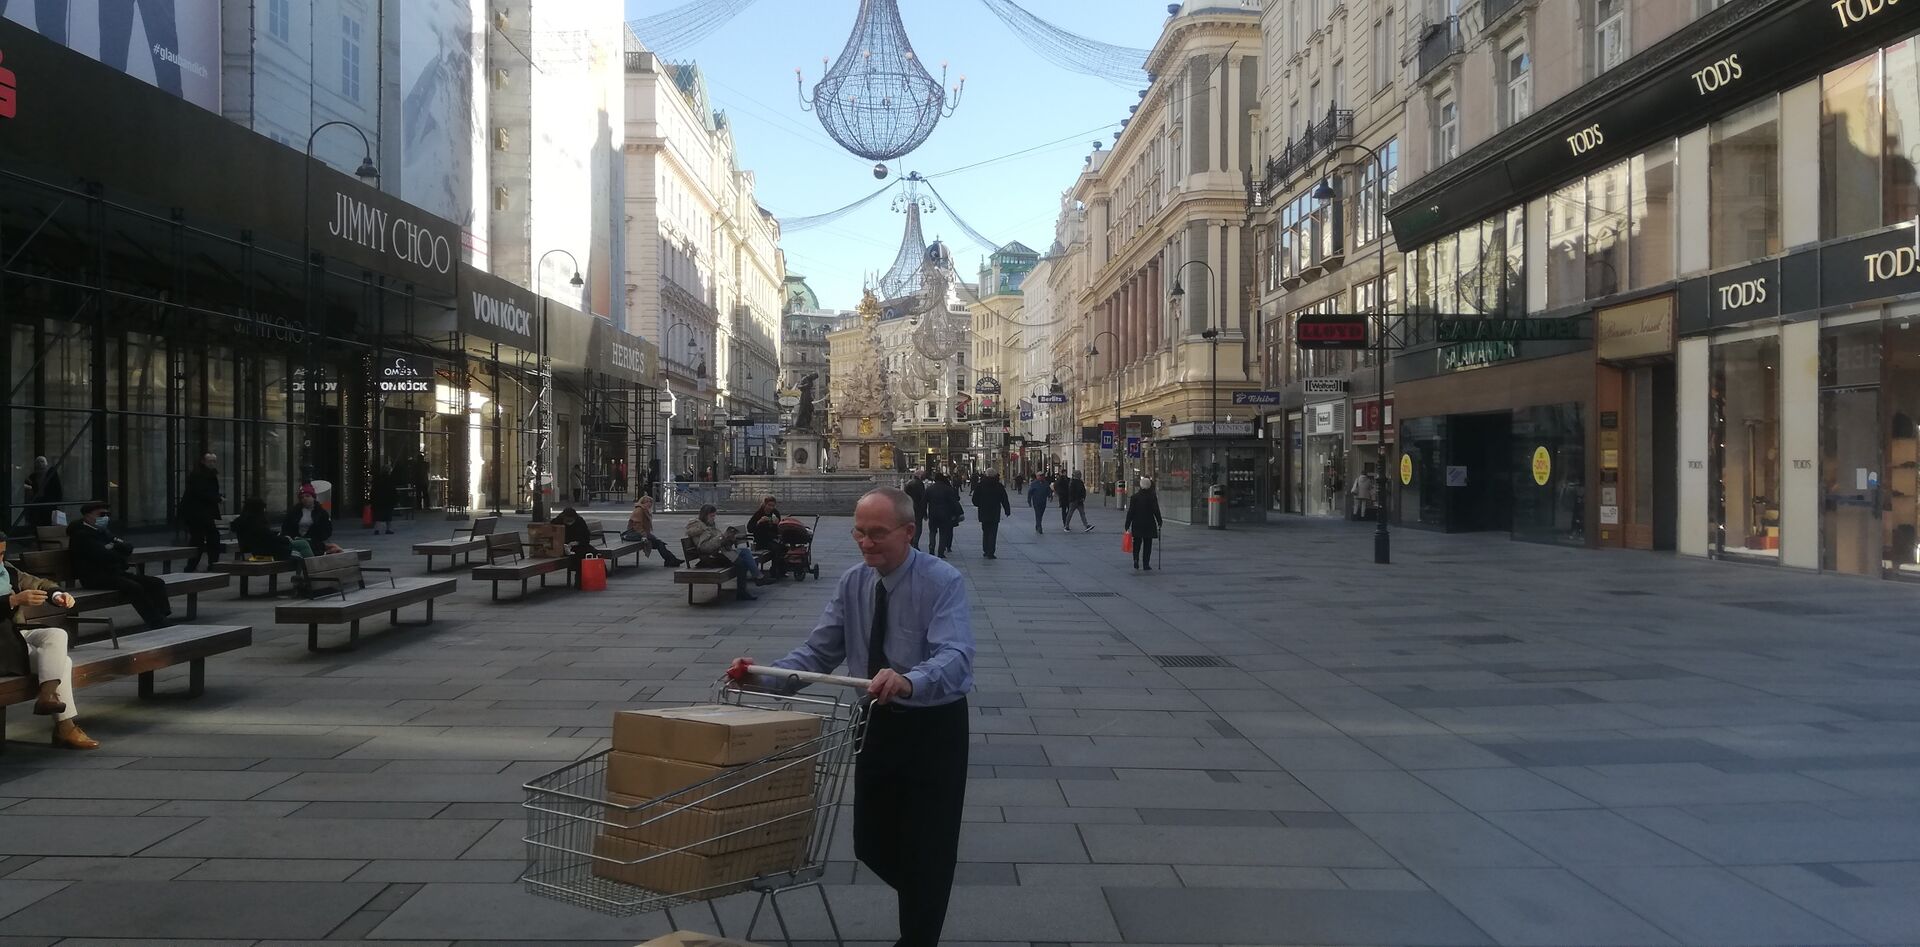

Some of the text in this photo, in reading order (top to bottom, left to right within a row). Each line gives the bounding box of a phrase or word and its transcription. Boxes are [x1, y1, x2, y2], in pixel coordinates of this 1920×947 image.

[1691, 53, 1742, 95] TOD'S
[1566, 123, 1604, 156] TOD'S
[329, 192, 451, 274] JIMMY CHOO
[1718, 277, 1766, 310] TOD'S
[472, 291, 531, 337] VON KÖCK
[1311, 382, 1337, 390] Wolford
